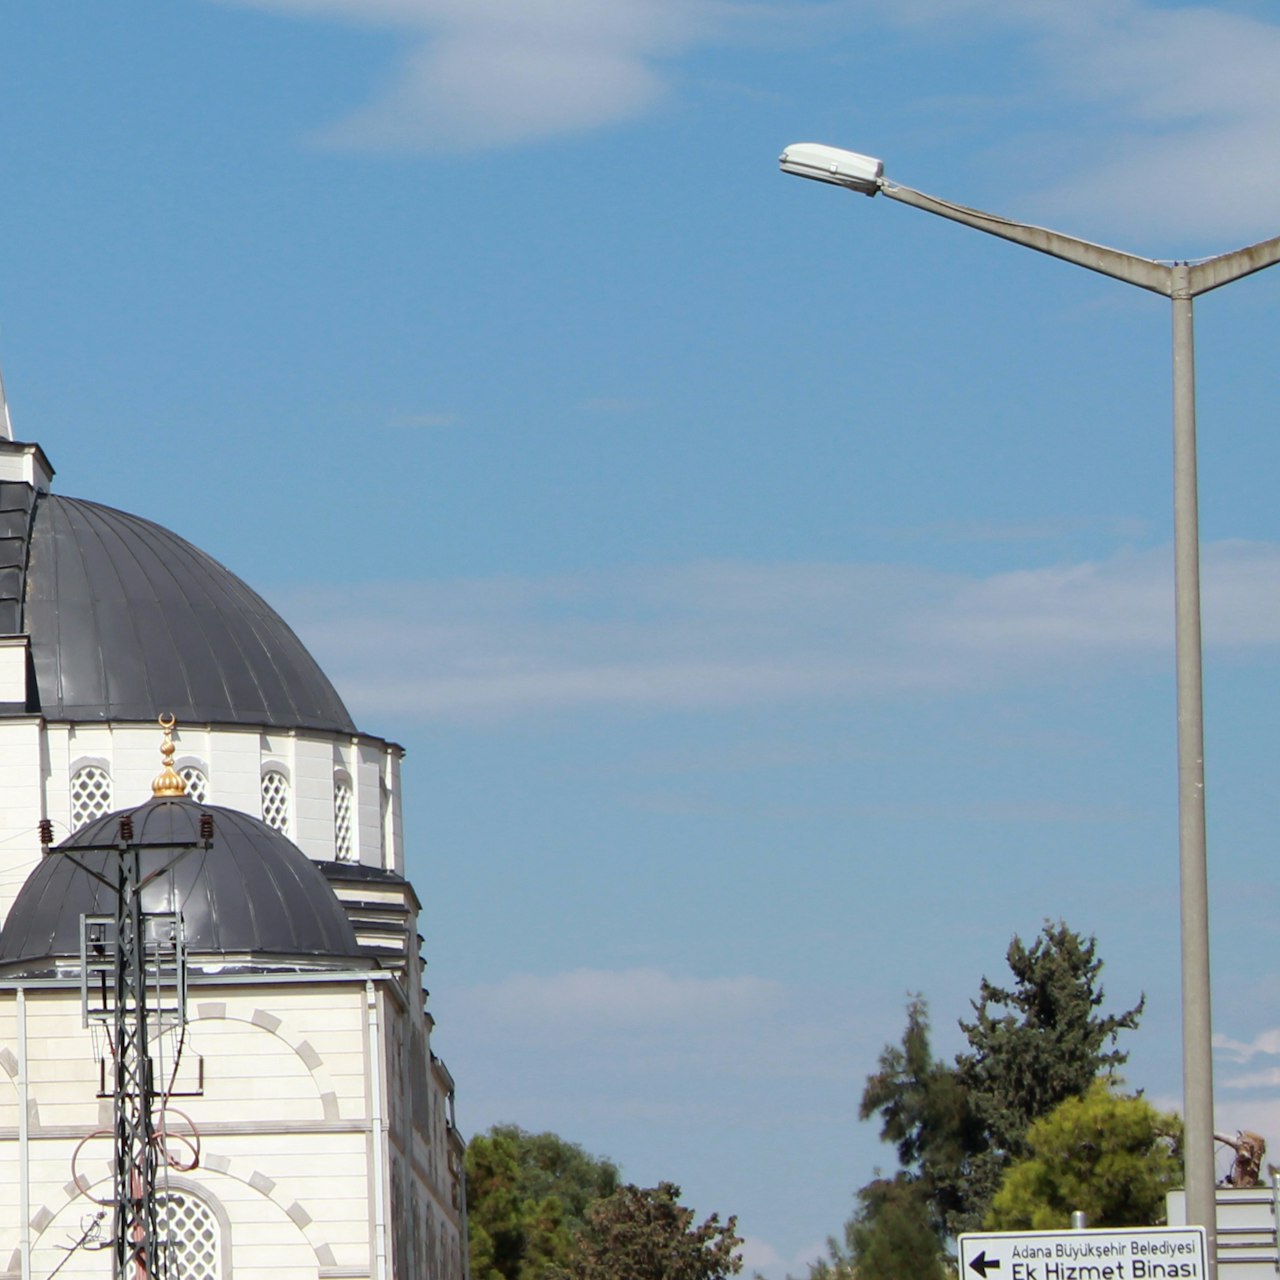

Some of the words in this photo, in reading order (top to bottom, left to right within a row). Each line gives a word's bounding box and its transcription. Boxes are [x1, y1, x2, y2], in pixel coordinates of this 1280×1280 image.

[1012, 1245, 1052, 1259] Adana
[1055, 1242, 1127, 1261] Büyükşehir
[1131, 1240, 1196, 1258] Belediyesi
[1012, 1262, 1038, 1280] Ek
[1045, 1261, 1124, 1280] Hizmet
[1132, 1260, 1197, 1279] Binası
